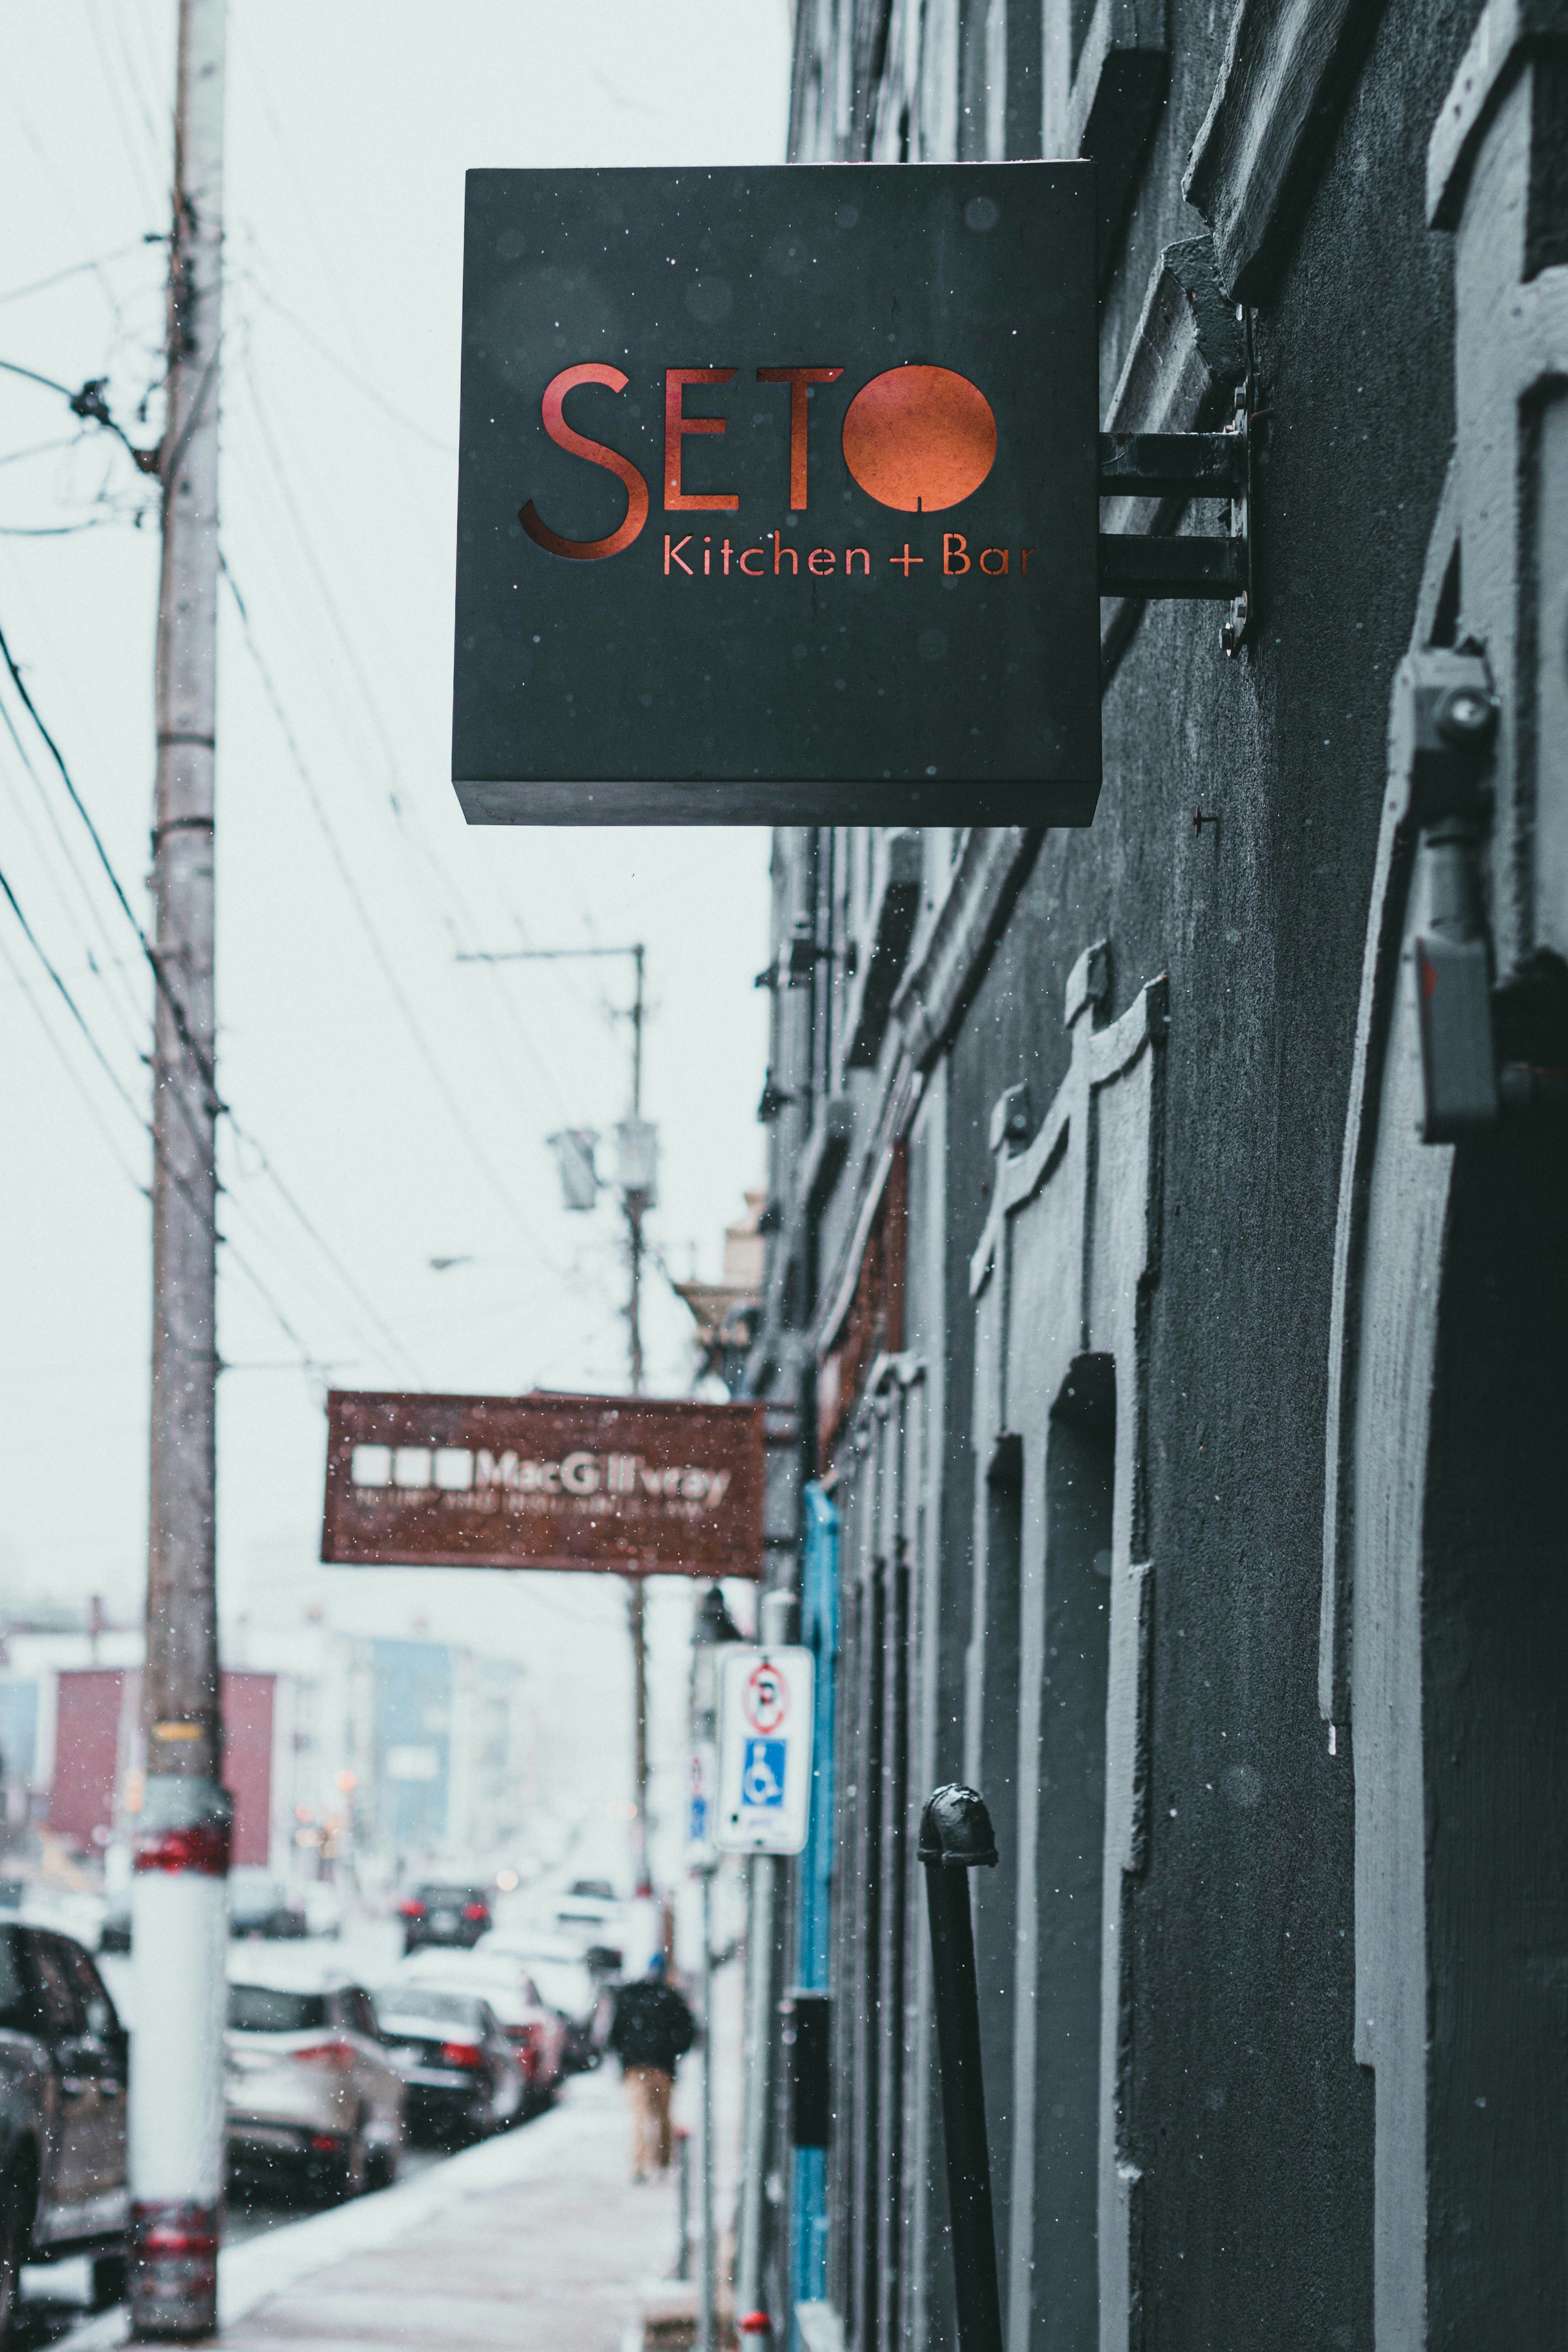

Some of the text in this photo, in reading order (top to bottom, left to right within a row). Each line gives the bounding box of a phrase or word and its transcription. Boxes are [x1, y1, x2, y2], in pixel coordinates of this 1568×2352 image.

[664, 530, 1037, 577] Kitchen + Bar
